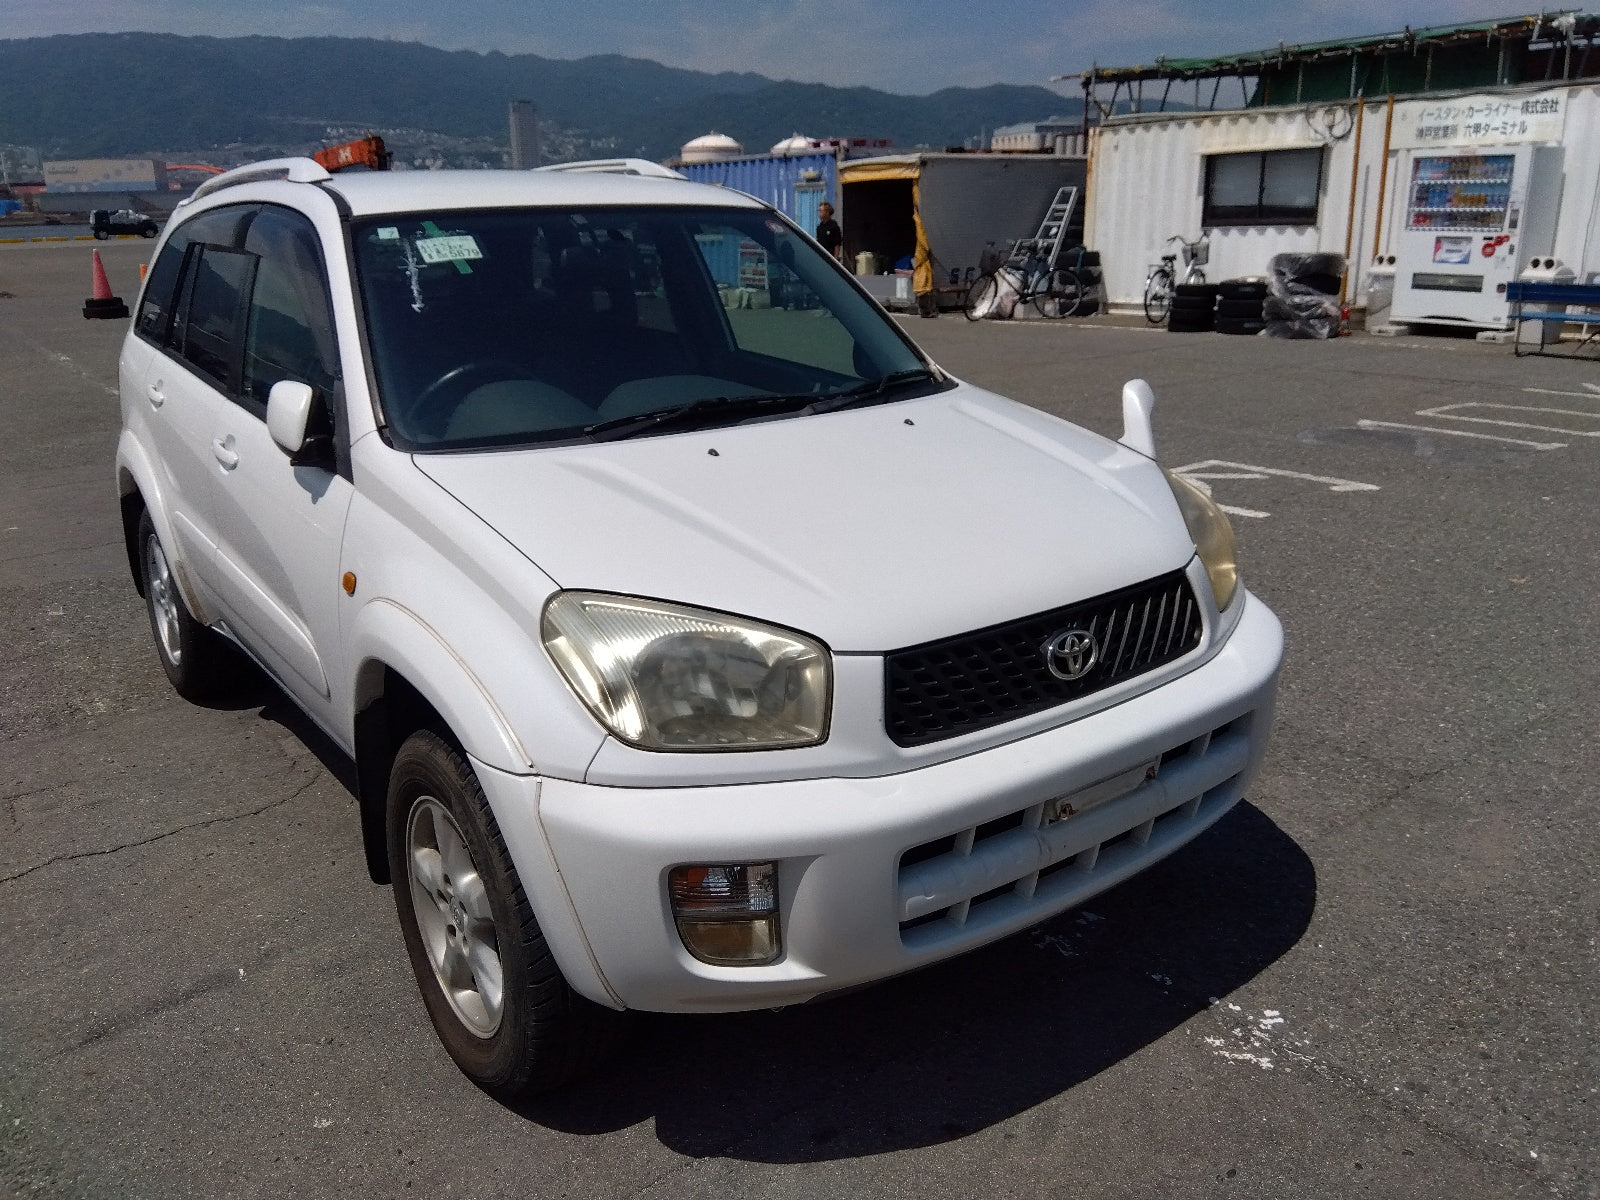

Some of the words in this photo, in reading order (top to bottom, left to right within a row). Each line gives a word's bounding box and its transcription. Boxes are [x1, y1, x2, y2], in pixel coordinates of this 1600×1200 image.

[1464, 120, 1528, 138] 六甲ターミナル
